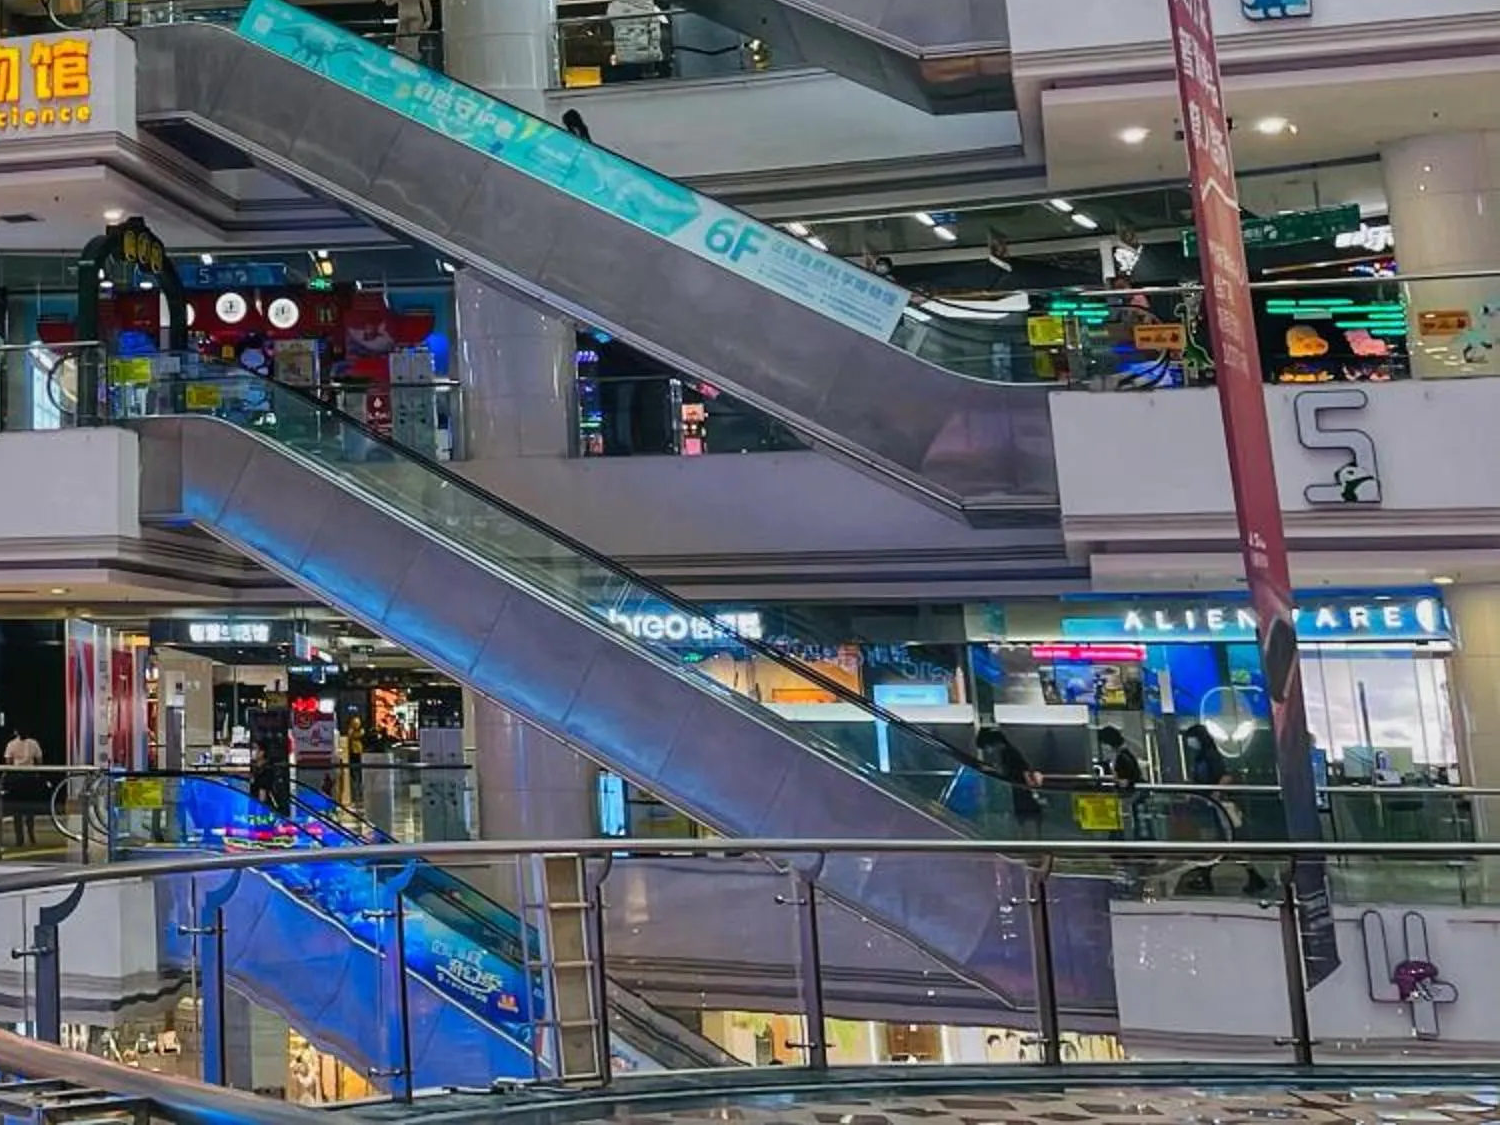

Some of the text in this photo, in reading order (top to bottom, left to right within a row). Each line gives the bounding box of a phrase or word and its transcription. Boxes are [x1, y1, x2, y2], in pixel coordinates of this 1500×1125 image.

[703, 218, 768, 267] 6F
[1293, 389, 1383, 506] 5
[1123, 606, 1401, 631] ALIENARE
